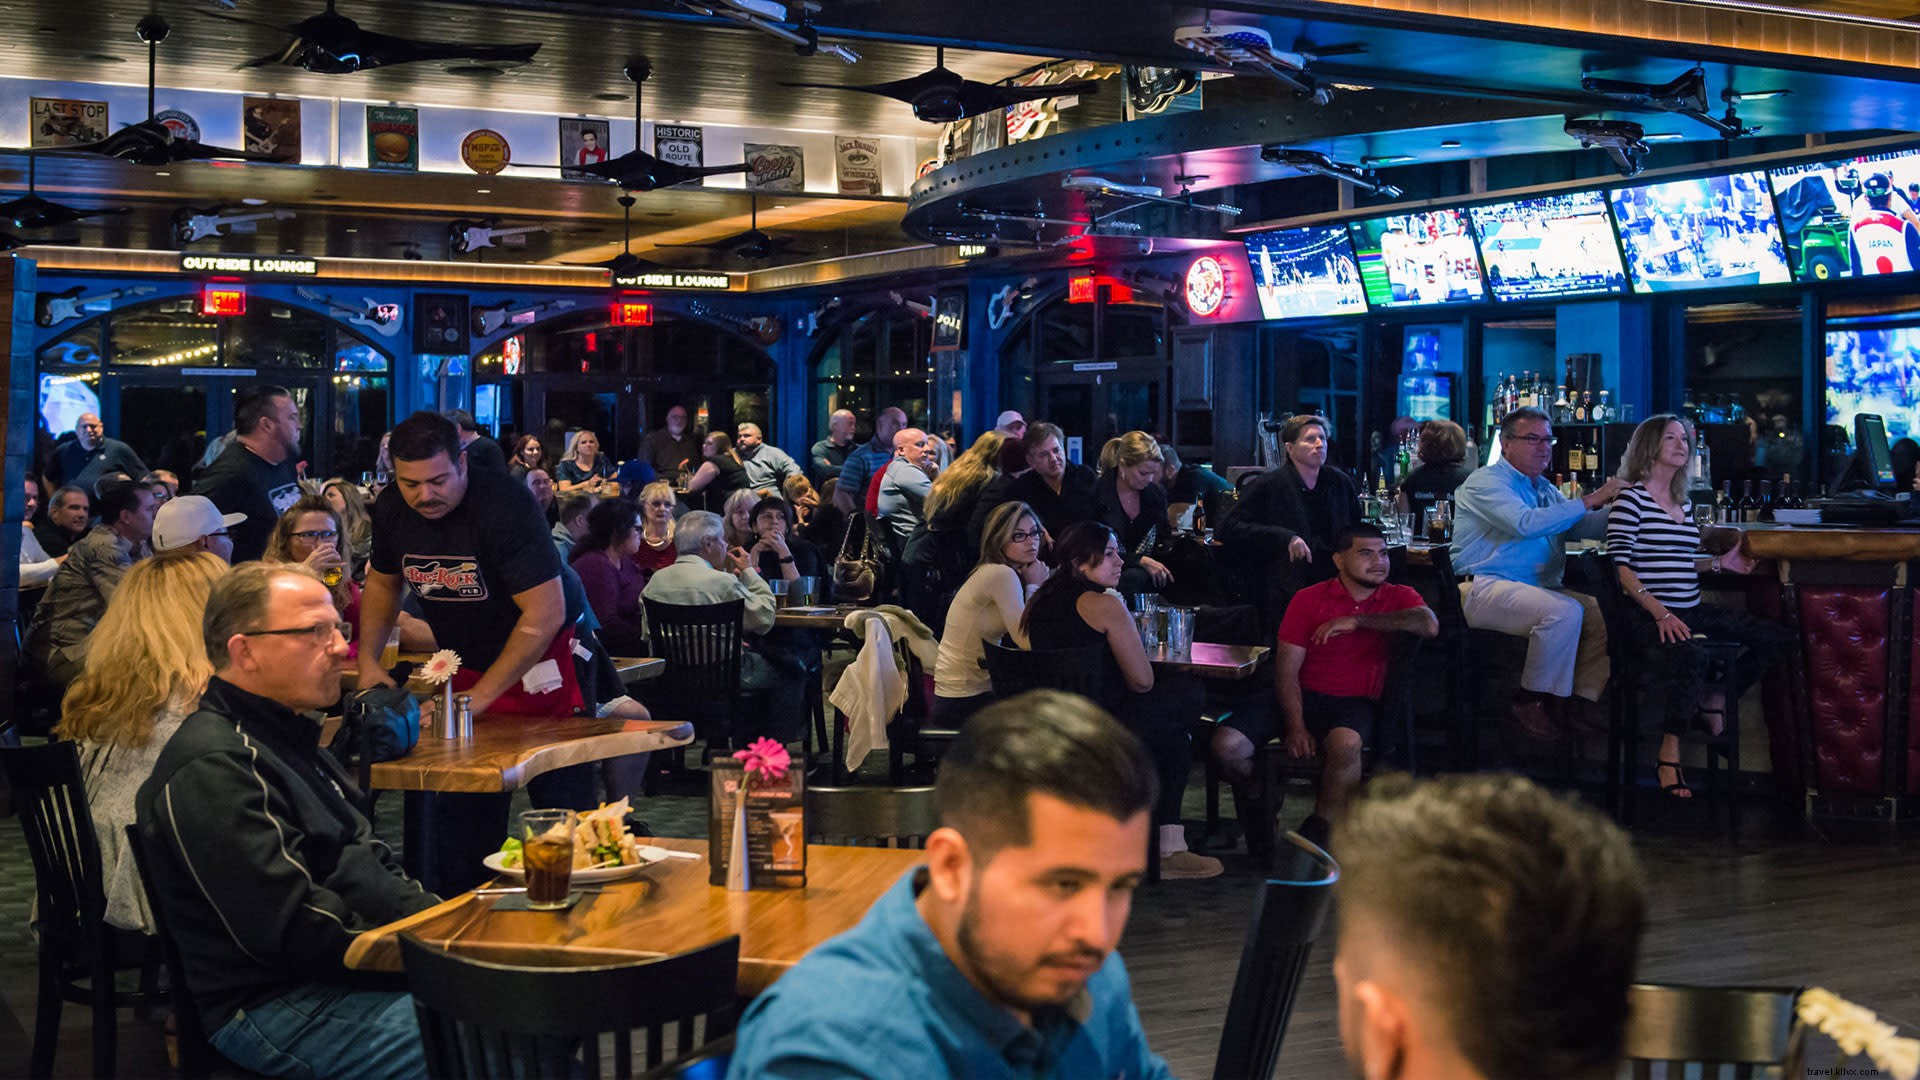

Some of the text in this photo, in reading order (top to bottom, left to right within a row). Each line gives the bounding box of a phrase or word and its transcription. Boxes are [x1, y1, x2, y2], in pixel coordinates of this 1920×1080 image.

[34, 102, 105, 118] LAST STOP
[656, 127, 701, 138] HISTORIC
[668, 144, 690, 153] OLD
[665, 153, 693, 161] ROUTE
[1868, 239, 1894, 248] JAPAN
[183, 257, 316, 273] OUTSIDE LOUNGE
[675, 275, 729, 288] LOUNGE
[212, 291, 240, 312] EXIT
[623, 304, 648, 324] EXIT
[461, 587, 479, 595] PUB
